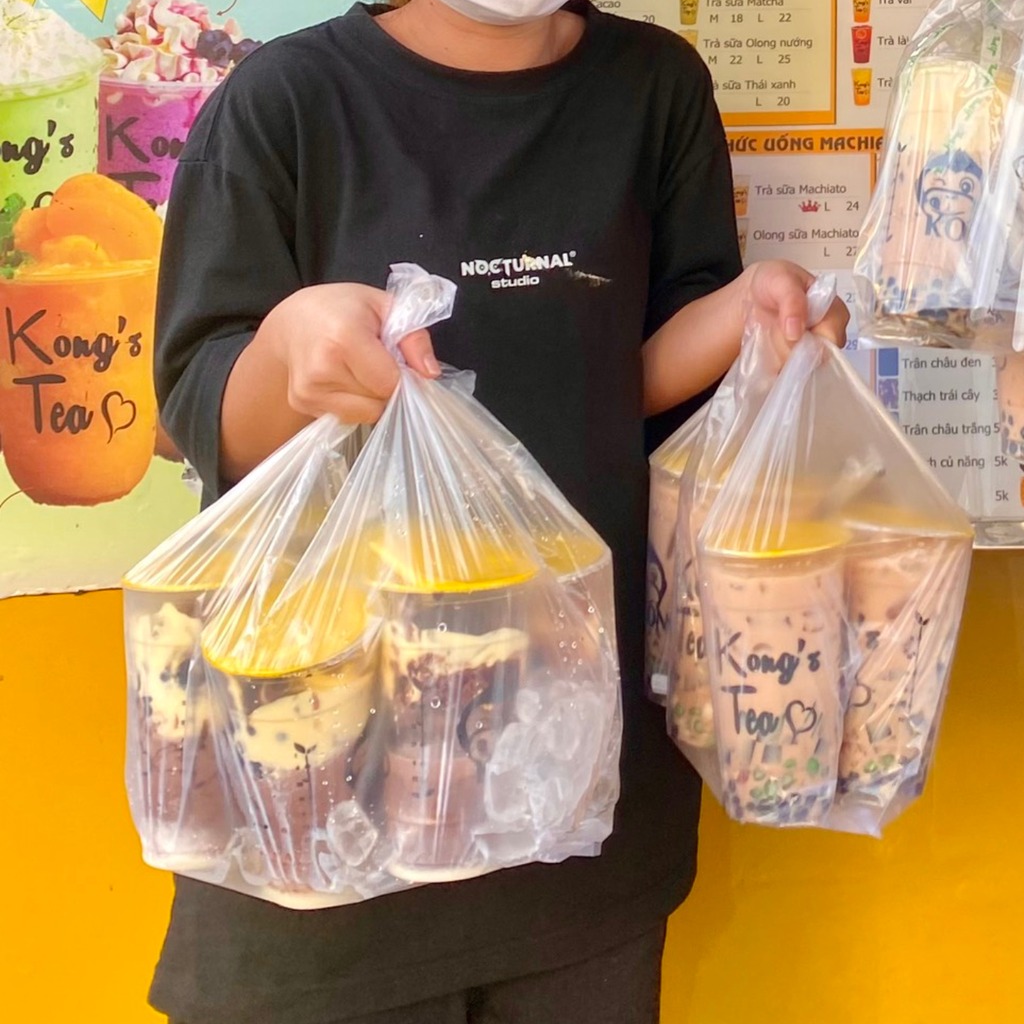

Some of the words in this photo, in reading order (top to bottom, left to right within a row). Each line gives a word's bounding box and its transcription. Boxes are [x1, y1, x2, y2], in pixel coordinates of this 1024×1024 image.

[709, 14, 718, 23] M
[731, 14, 743, 23] 18
[757, 13, 764, 23] L
[779, 13, 791, 23] 22
[703, 37, 721, 48] Trà
[724, 38, 743, 48] sữa
[746, 38, 776, 49] Olong
[877, 35, 894, 46] Trà
[708, 55, 717, 65] M
[729, 55, 742, 65] 22
[757, 55, 763, 64] L
[778, 55, 791, 64] 25
[745, 79, 767, 90] Thái
[771, 79, 796, 90] xanh
[755, 97, 762, 106] L
[777, 97, 790, 106] 20
[764, 133, 814, 151] UỐNG
[755, 184, 773, 196] Trà
[776, 184, 795, 196] sữa
[799, 183, 847, 195] Machiato
[824, 202, 830, 212] L
[846, 201, 859, 211] 24
[753, 229, 785, 242] Olong
[788, 228, 808, 241] sữa
[811, 228, 859, 240] Machiato
[824, 247, 830, 257] L
[491, 275, 540, 289] studio
[6, 306, 142, 372] Kong's
[931, 357, 957, 368] châu
[960, 357, 982, 368] đen
[901, 391, 936, 403] Thạch
[940, 390, 958, 401] trái
[961, 389, 980, 402] cây
[13, 374, 94, 435] Tea
[932, 424, 958, 435] châu
[994, 456, 1008, 467] 5k
[995, 490, 1009, 500] 5k
[721, 685, 779, 735] Tea
